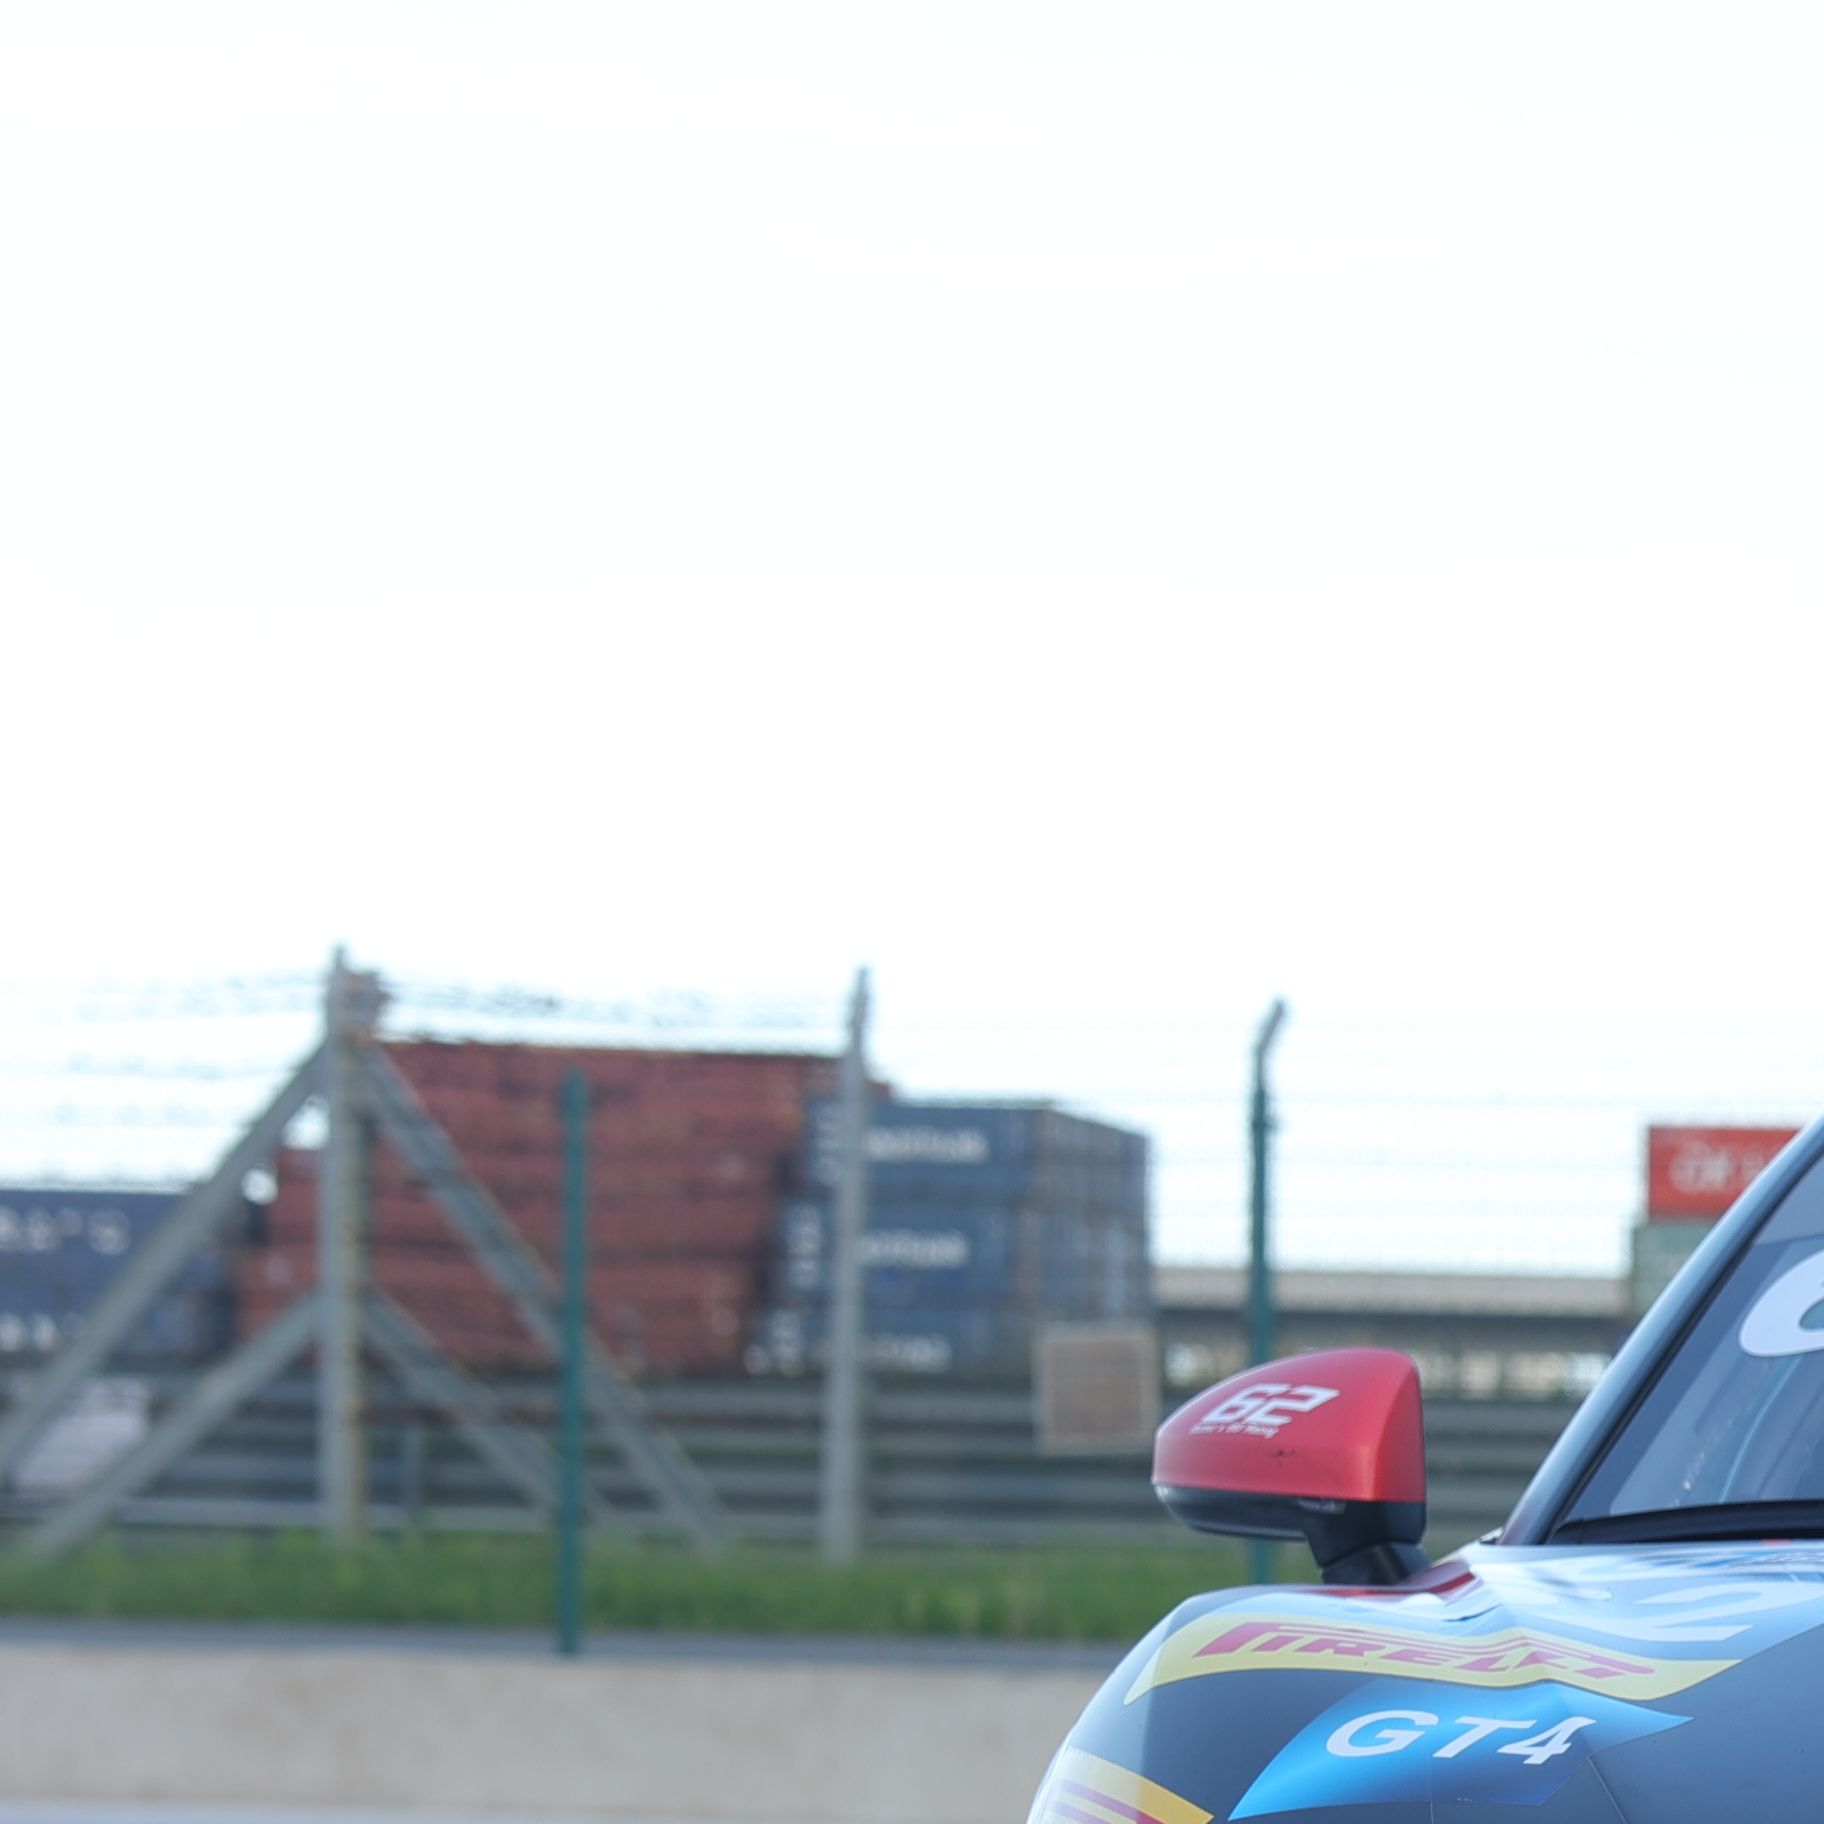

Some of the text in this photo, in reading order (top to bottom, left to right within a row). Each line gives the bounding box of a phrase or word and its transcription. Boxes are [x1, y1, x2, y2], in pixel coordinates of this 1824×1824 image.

[1200, 1383, 1341, 1427] 62
[1192, 1621, 1656, 1679] PIRELLI
[1325, 1710, 1597, 1765] GT4
